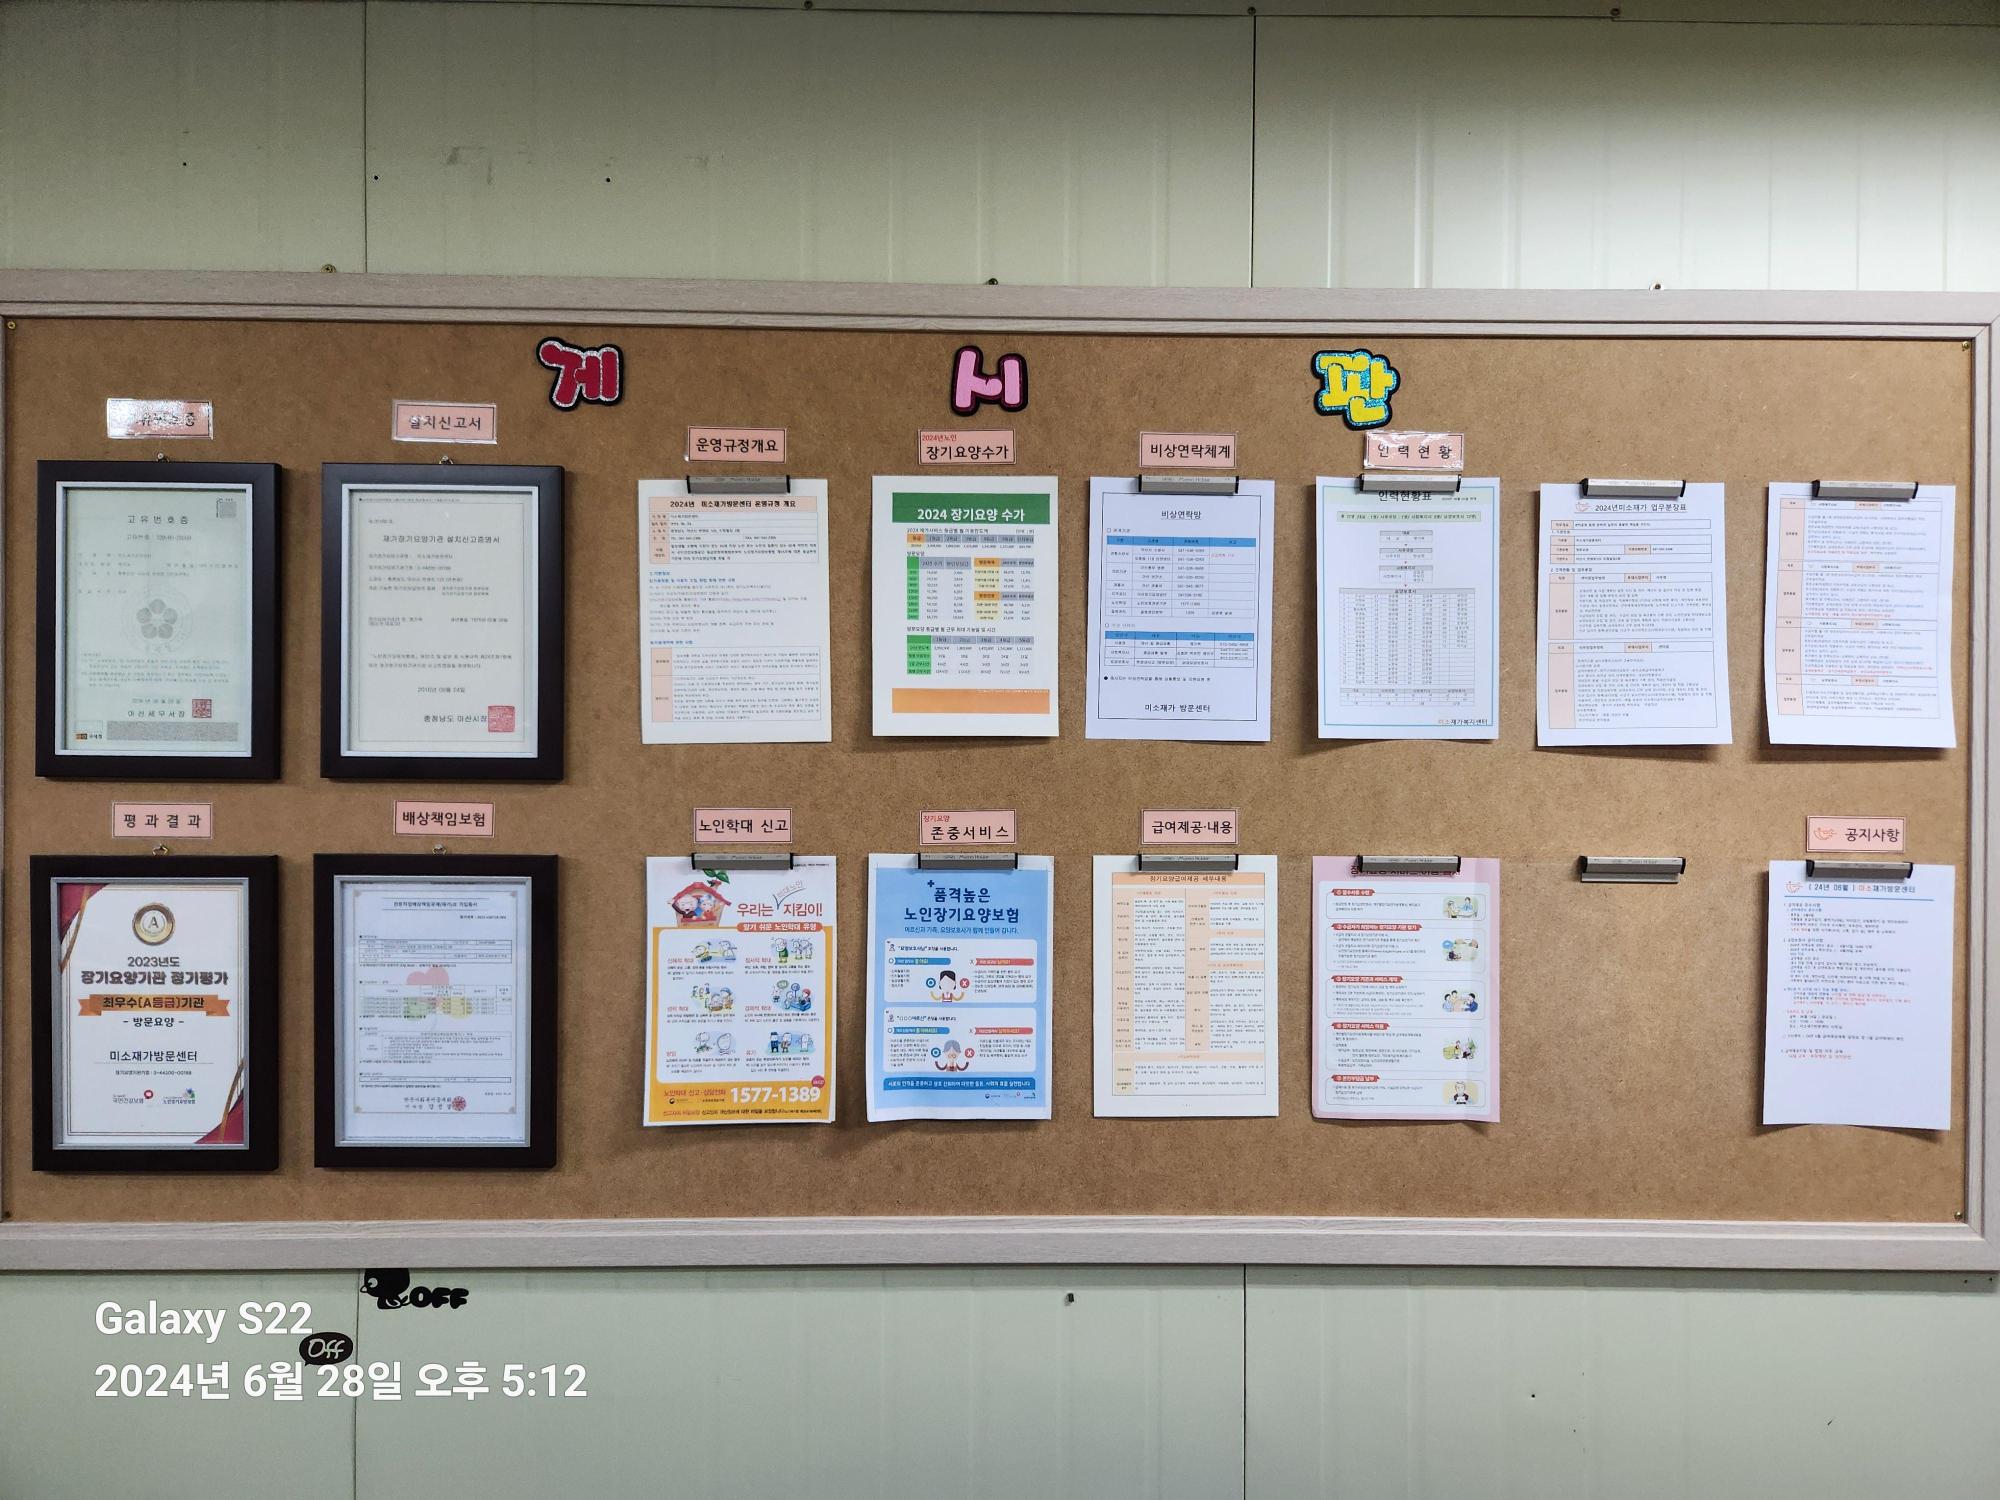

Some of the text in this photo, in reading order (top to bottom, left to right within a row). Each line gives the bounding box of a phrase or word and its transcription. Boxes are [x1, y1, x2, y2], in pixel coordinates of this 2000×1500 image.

[1312, 349, 1400, 430] 판
[408, 414, 482, 431] 설치신고서
[696, 437, 779, 454] 운영규정개요
[926, 445, 1009, 460] 장기요양수가
[1150, 443, 1231, 459] 비상연락체계
[916, 508, 1026, 523] 2024 장기요양 수가
[402, 811, 486, 827] 배상책임보험
[698, 819, 789, 834] 노인학대 신고
[923, 815, 950, 823] 장기요양
[930, 826, 1010, 841] 존중서비스
[1844, 827, 1900, 843] 공지사항
[933, 887, 991, 903] 품격높은
[736, 903, 823, 917] 우리는 지킴이!
[904, 907, 1020, 924] 노인장기요양보험
[127, 956, 181, 968] 2023년도
[80, 970, 229, 986] 장기요양기관 정기평가
[132, 1017, 175, 1028] 방문요양
[109, 1050, 198, 1063] 미소재가방문센터
[730, 1086, 821, 1104] 1577-1389
[409, 1286, 470, 1310] OFF
[307, 1338, 346, 1360] Off
